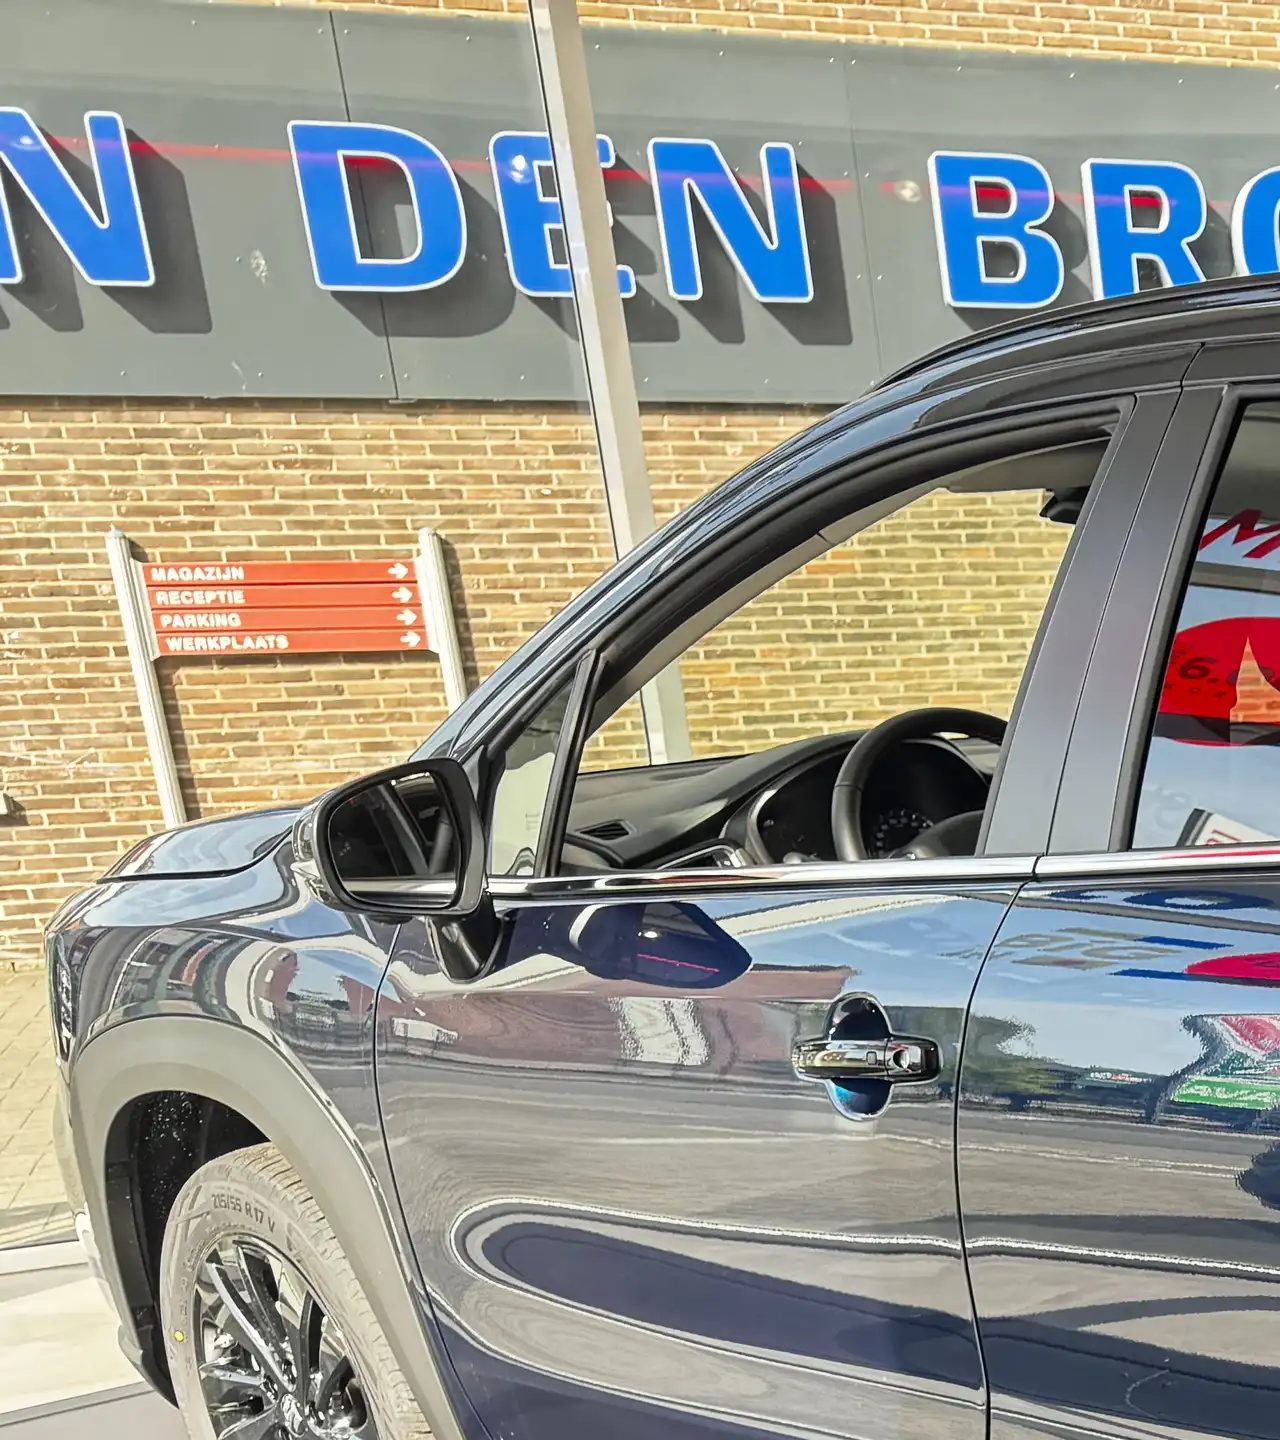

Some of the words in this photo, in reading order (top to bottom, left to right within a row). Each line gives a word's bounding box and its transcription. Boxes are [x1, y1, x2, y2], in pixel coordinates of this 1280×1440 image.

[287, 119, 815, 304] DEN
[151, 566, 244, 582] MAGAZIJN
[156, 590, 246, 605] RECEPTIE
[160, 612, 241, 629] PARKING
[165, 634, 288, 651] WERKPLAATS
